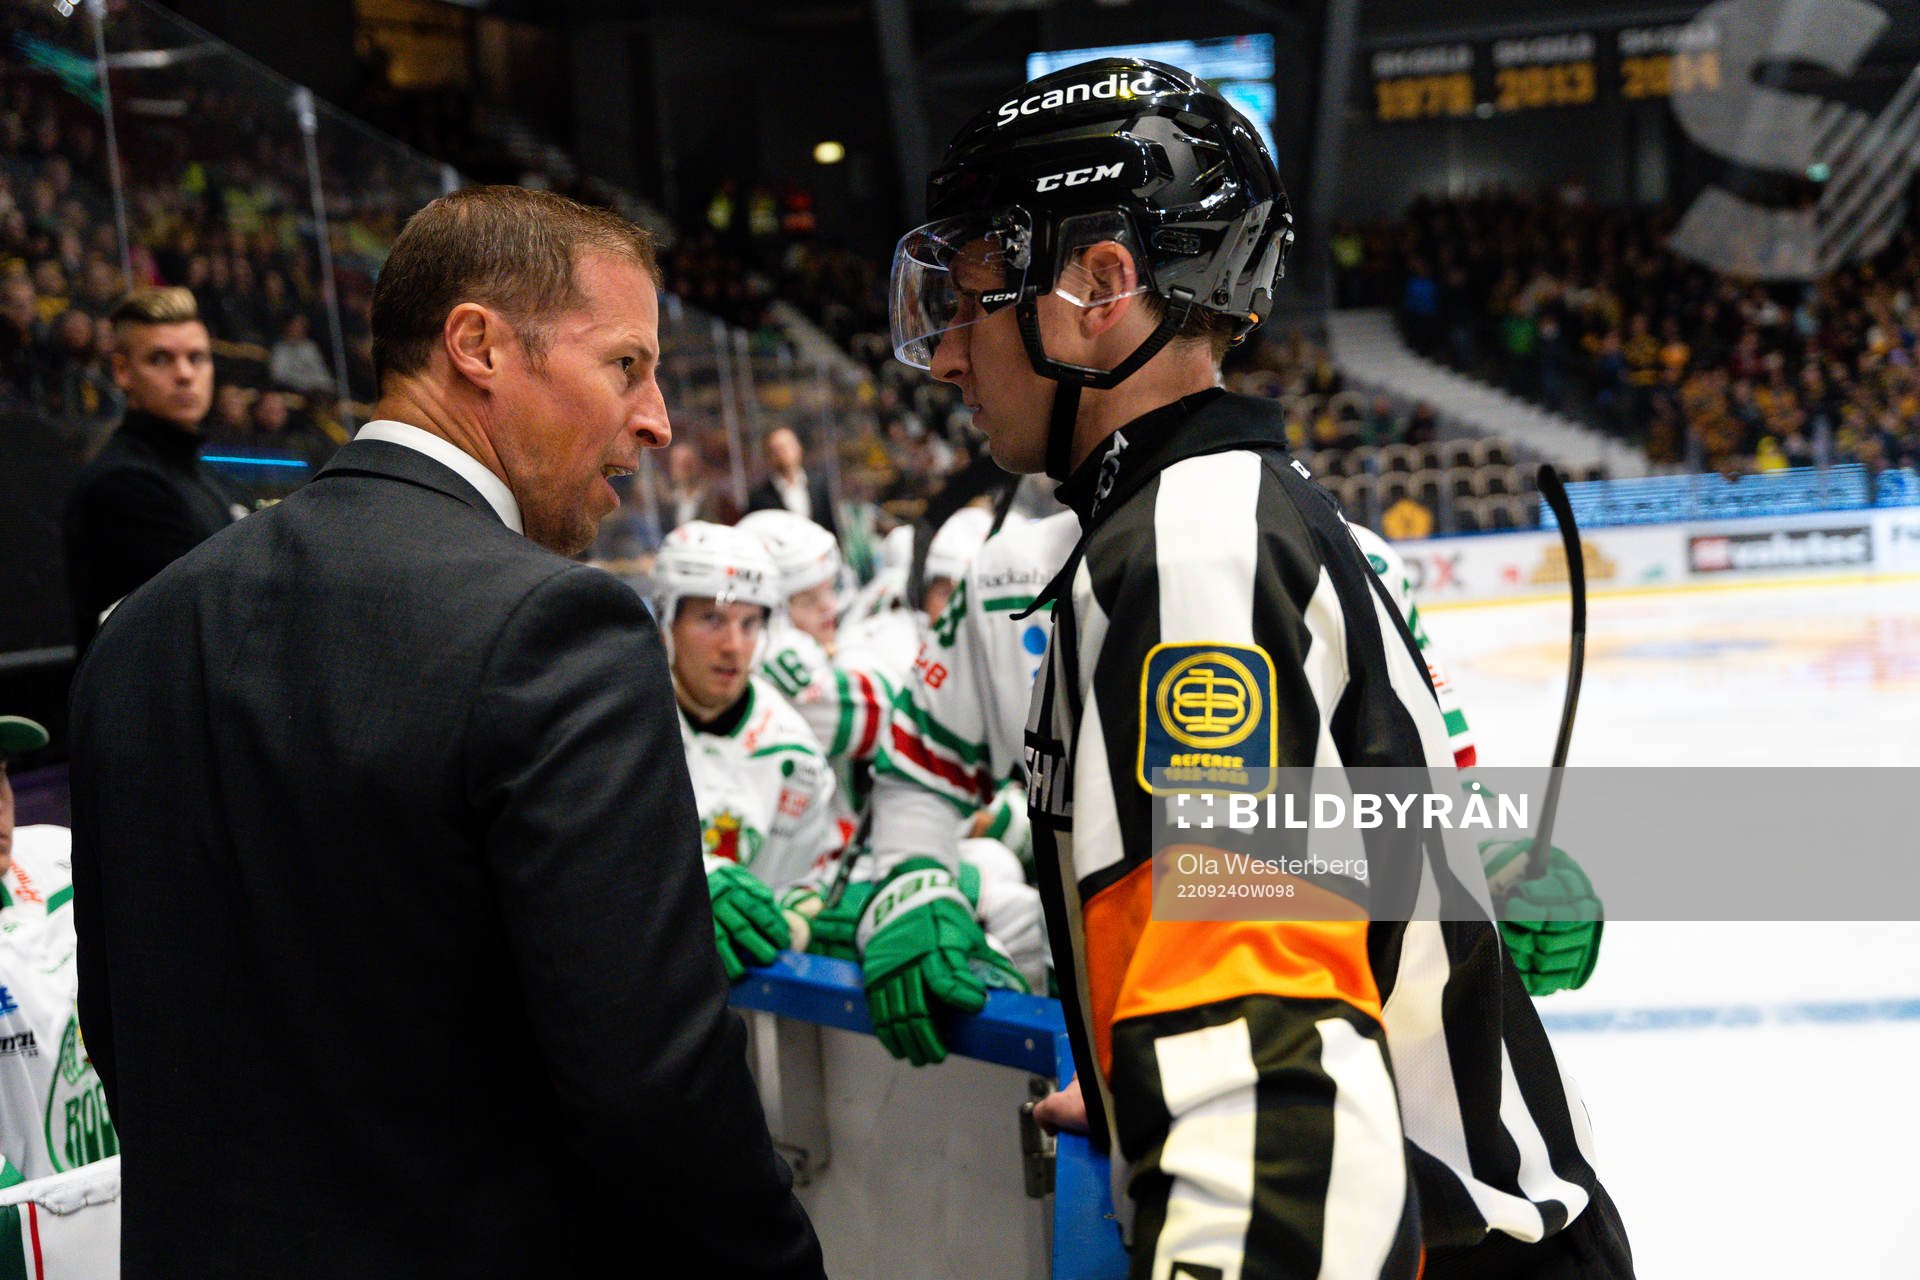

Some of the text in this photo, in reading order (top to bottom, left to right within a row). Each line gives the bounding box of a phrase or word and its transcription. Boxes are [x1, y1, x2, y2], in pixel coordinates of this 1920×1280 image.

[997, 74, 1156, 127] Scandic
[1036, 162, 1124, 192] CCM
[982, 291, 1018, 303] CCM
[1170, 753, 1245, 768] REFEREE
